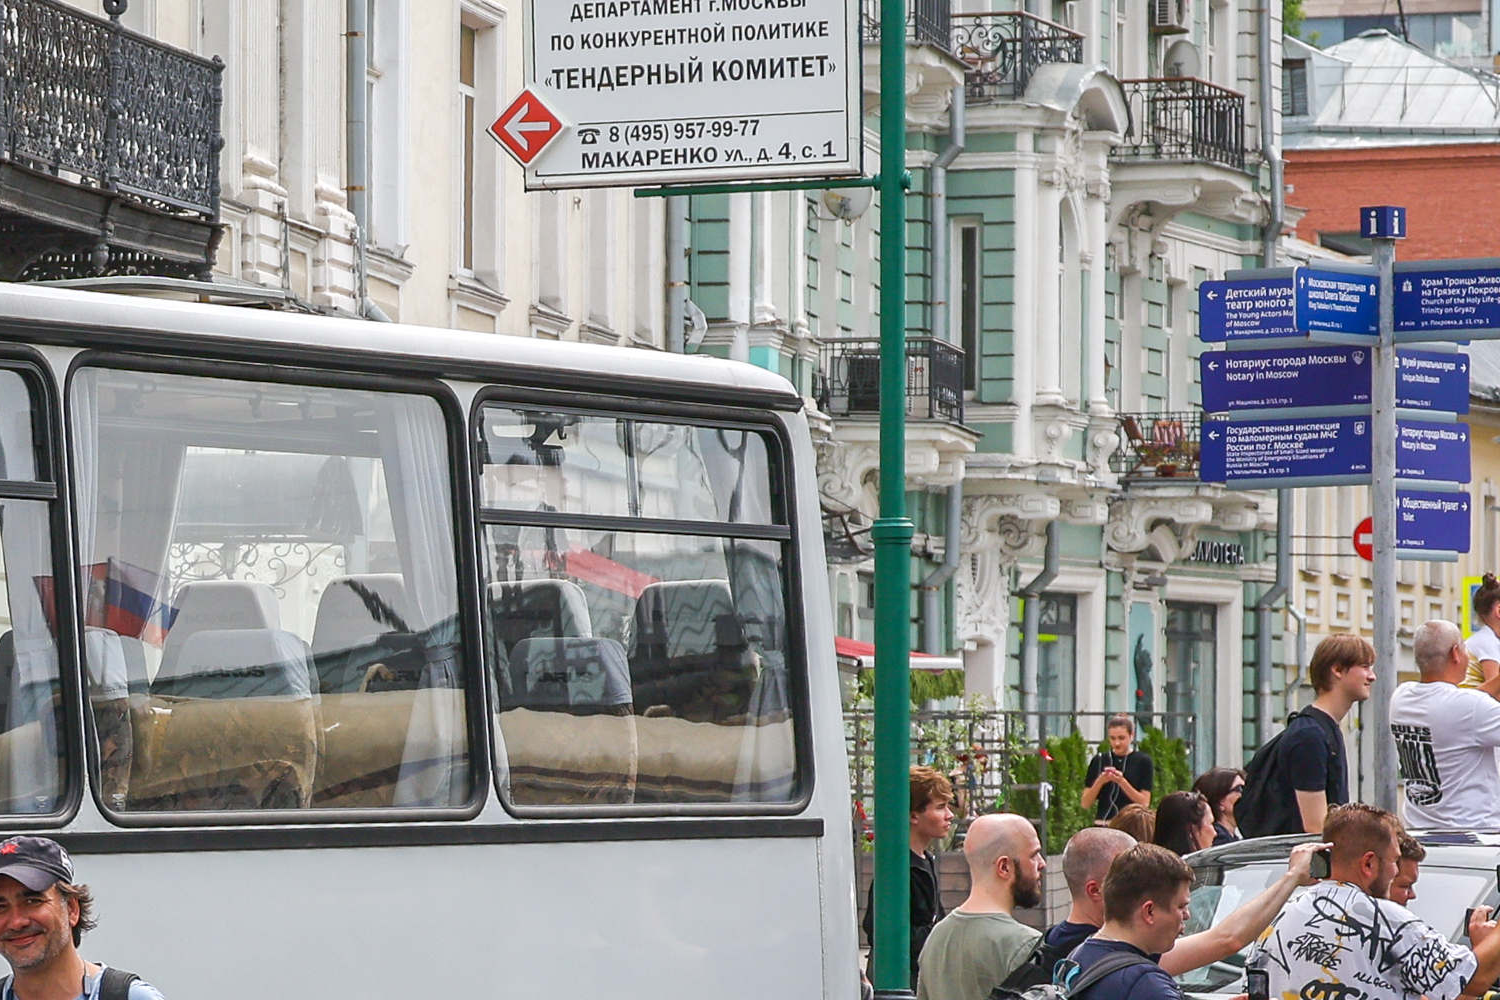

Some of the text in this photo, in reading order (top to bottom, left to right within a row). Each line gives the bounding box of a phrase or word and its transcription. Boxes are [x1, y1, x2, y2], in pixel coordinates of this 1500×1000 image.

[570, 0, 707, 22] ДЕПАРТАМЕНТ
[551, 20, 829, 51] ПО КОНКУРЕНТНОЙ ПОЛИТИКЕ
[544, 54, 836, 91] «ТЕНДЕРНЫЙ КОМИТЕТ»
[609, 119, 760, 145] 8 (495) 957-99-77
[581, 146, 718, 169] МАКАРЕНКО
[756, 147, 773, 163] д.
[778, 142, 796, 161] 4,
[822, 140, 837, 158] 1
[1421, 278, 1443, 288] Храм
[1444, 277, 1477, 287] Троицы
[1225, 287, 1267, 300] Детский
[1433, 287, 1460, 297] Грязех
[1461, 288, 1466, 296] у
[1226, 301, 1253, 311] театр
[1255, 299, 1285, 309] юного
[1466, 297, 1481, 305] Holy
[1239, 311, 1260, 321] Young
[1260, 310, 1282, 318] Actors
[1421, 307, 1443, 315] Trinity
[1454, 306, 1476, 315] Gryazy
[1234, 319, 1260, 328] Moscow
[1225, 355, 1347, 370] Нотариус города Москвы
[1226, 370, 1299, 382] Notary in Moscow
[1226, 423, 1340, 436] Государственная инспекция
[1226, 430, 1338, 443] по маломерным судам МЧС
[1226, 443, 1255, 452] России
[1267, 442, 1273, 450] г.
[1275, 441, 1304, 450] Москве
[1402, 497, 1441, 510] Общественный
[1391, 723, 1431, 735] RULES
